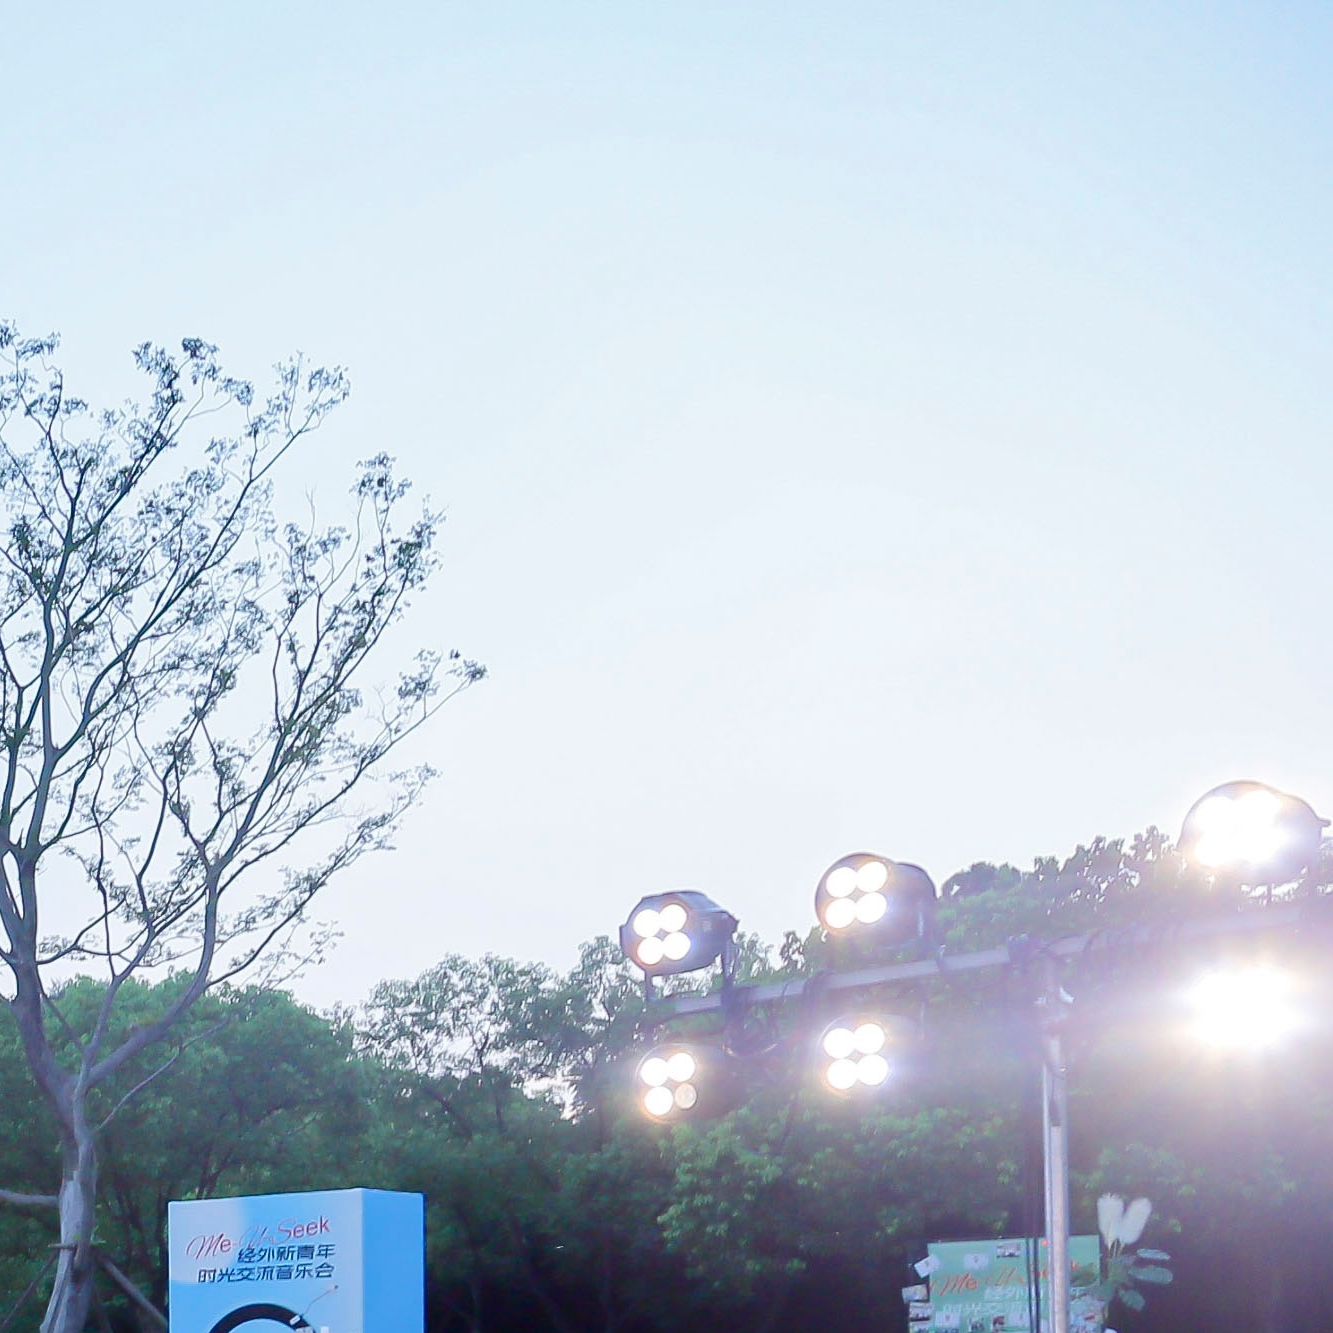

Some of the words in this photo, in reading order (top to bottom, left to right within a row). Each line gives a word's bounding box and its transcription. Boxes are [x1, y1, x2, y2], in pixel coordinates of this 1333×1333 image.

[237, 1243, 336, 1264] 经外新青年
[198, 1262, 335, 1284] 时光交流音乐会
